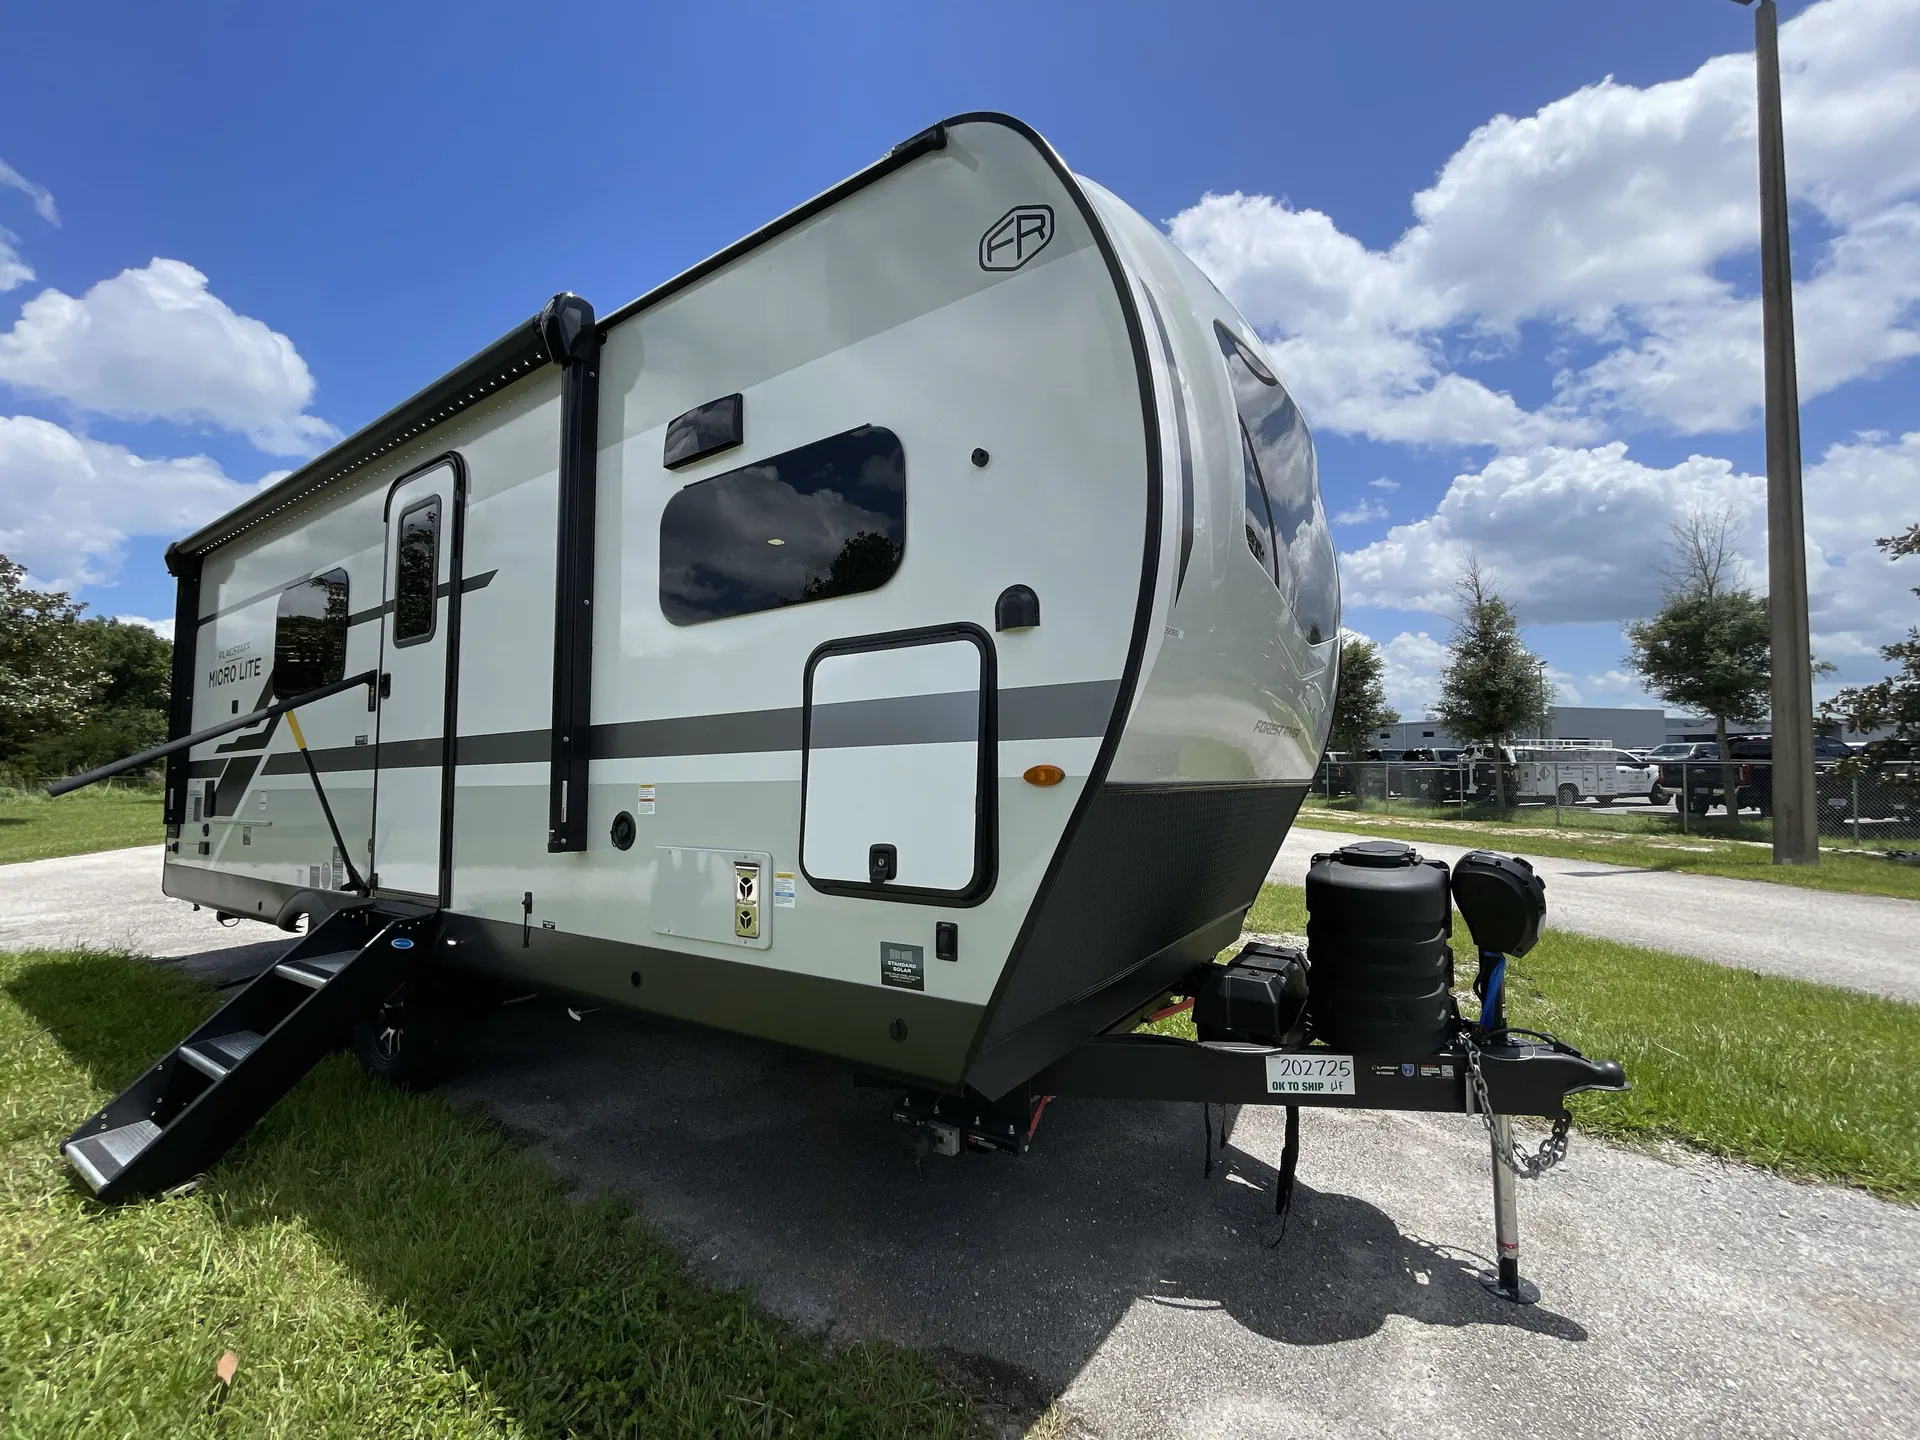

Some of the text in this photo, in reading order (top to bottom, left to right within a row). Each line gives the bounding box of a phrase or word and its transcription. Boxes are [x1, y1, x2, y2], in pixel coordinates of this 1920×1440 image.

[218, 641, 252, 660] FLAGSTAFF
[208, 657, 262, 688] MICRO LITE
[887, 960, 917, 969] STANDARD
[1280, 1058, 1351, 1077] 202725
[1272, 1081, 1324, 1092] OK TO SHIP
